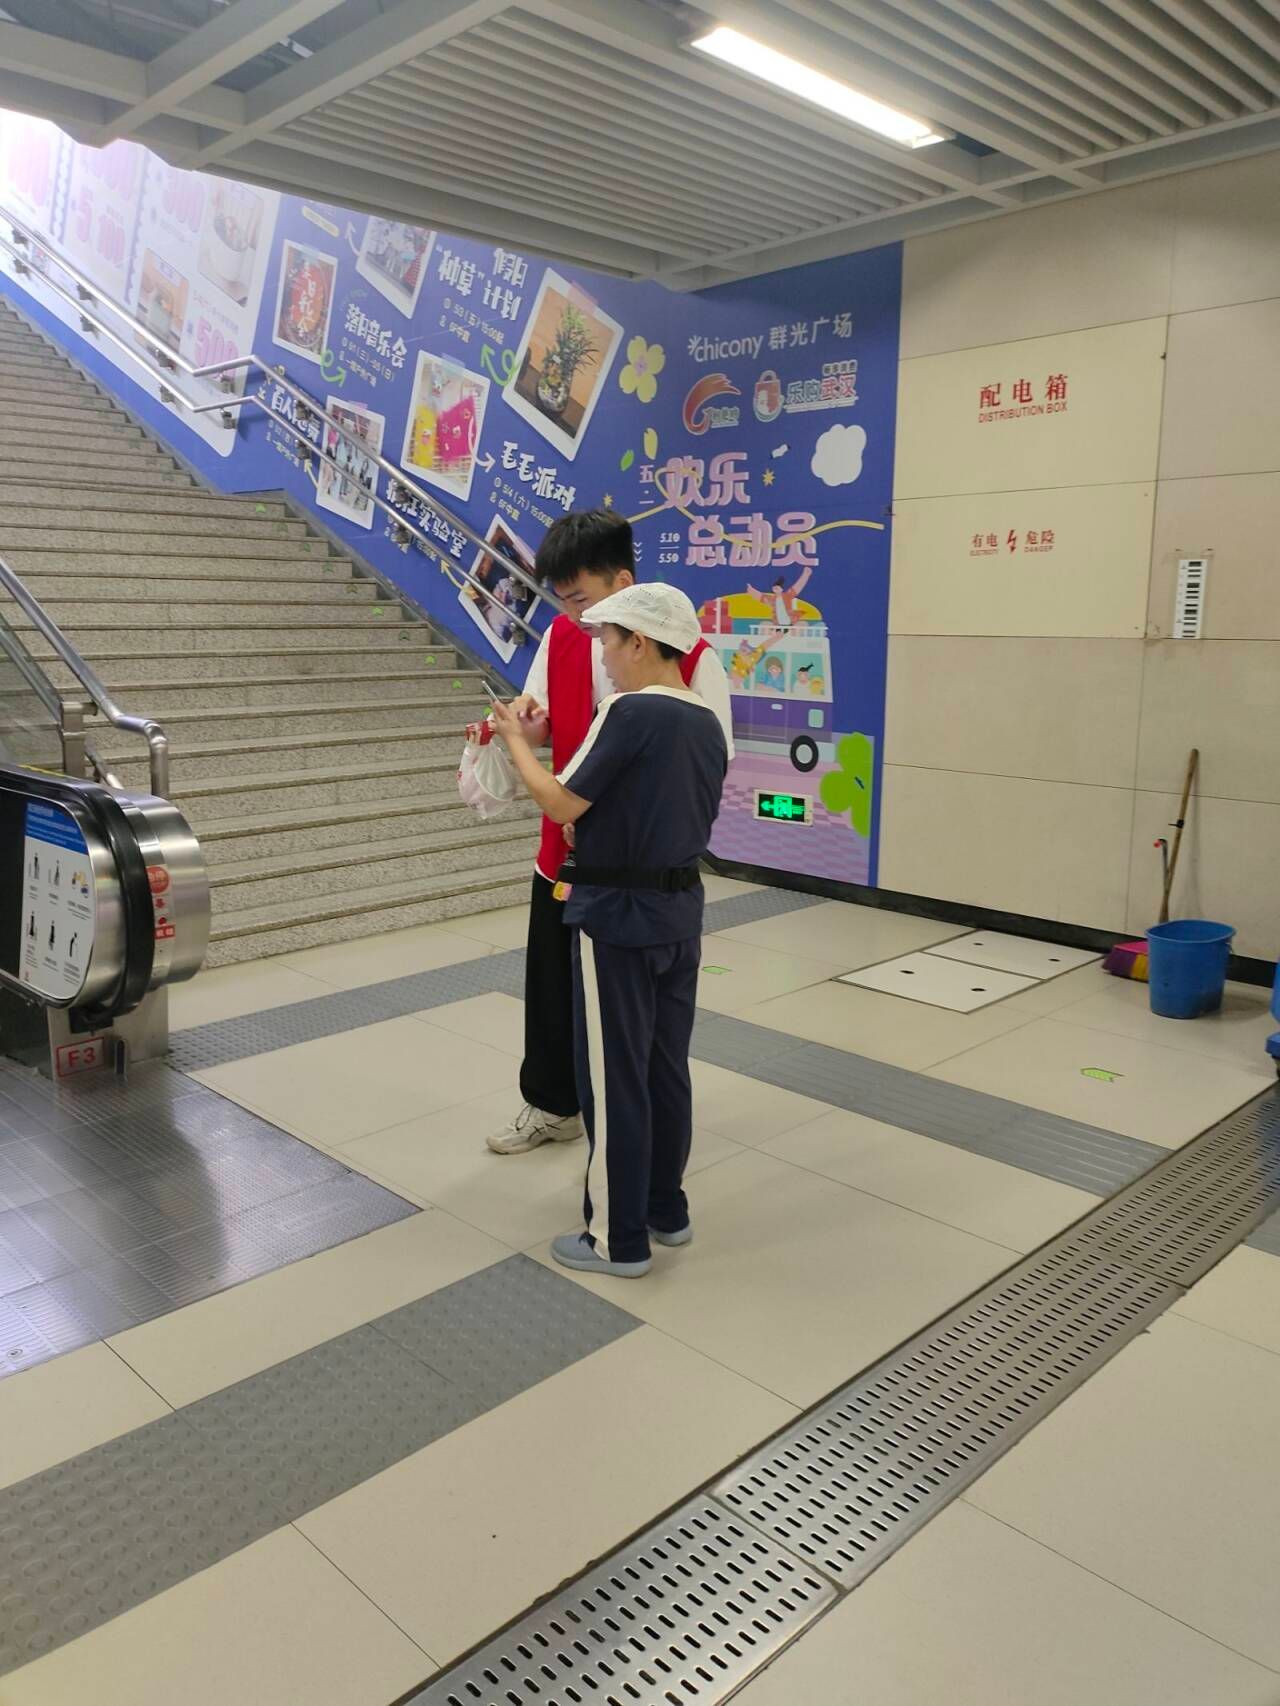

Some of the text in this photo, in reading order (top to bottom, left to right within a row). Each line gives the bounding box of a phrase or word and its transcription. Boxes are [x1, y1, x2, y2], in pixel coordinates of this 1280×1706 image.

[344, 303, 408, 368] 落日音乐会
[692, 312, 853, 362] chicony 群光广场
[786, 373, 858, 406] 乐购武汉
[979, 373, 1068, 409] 配电箱
[978, 401, 1067, 424] DISTRIBUTION BOX
[500, 440, 576, 512] 毛毛派对
[664, 452, 751, 507] 欢乐
[685, 511, 820, 568] 总动员
[972, 529, 1055, 548] 有电 危险
[67, 1046, 97, 1069] F3
